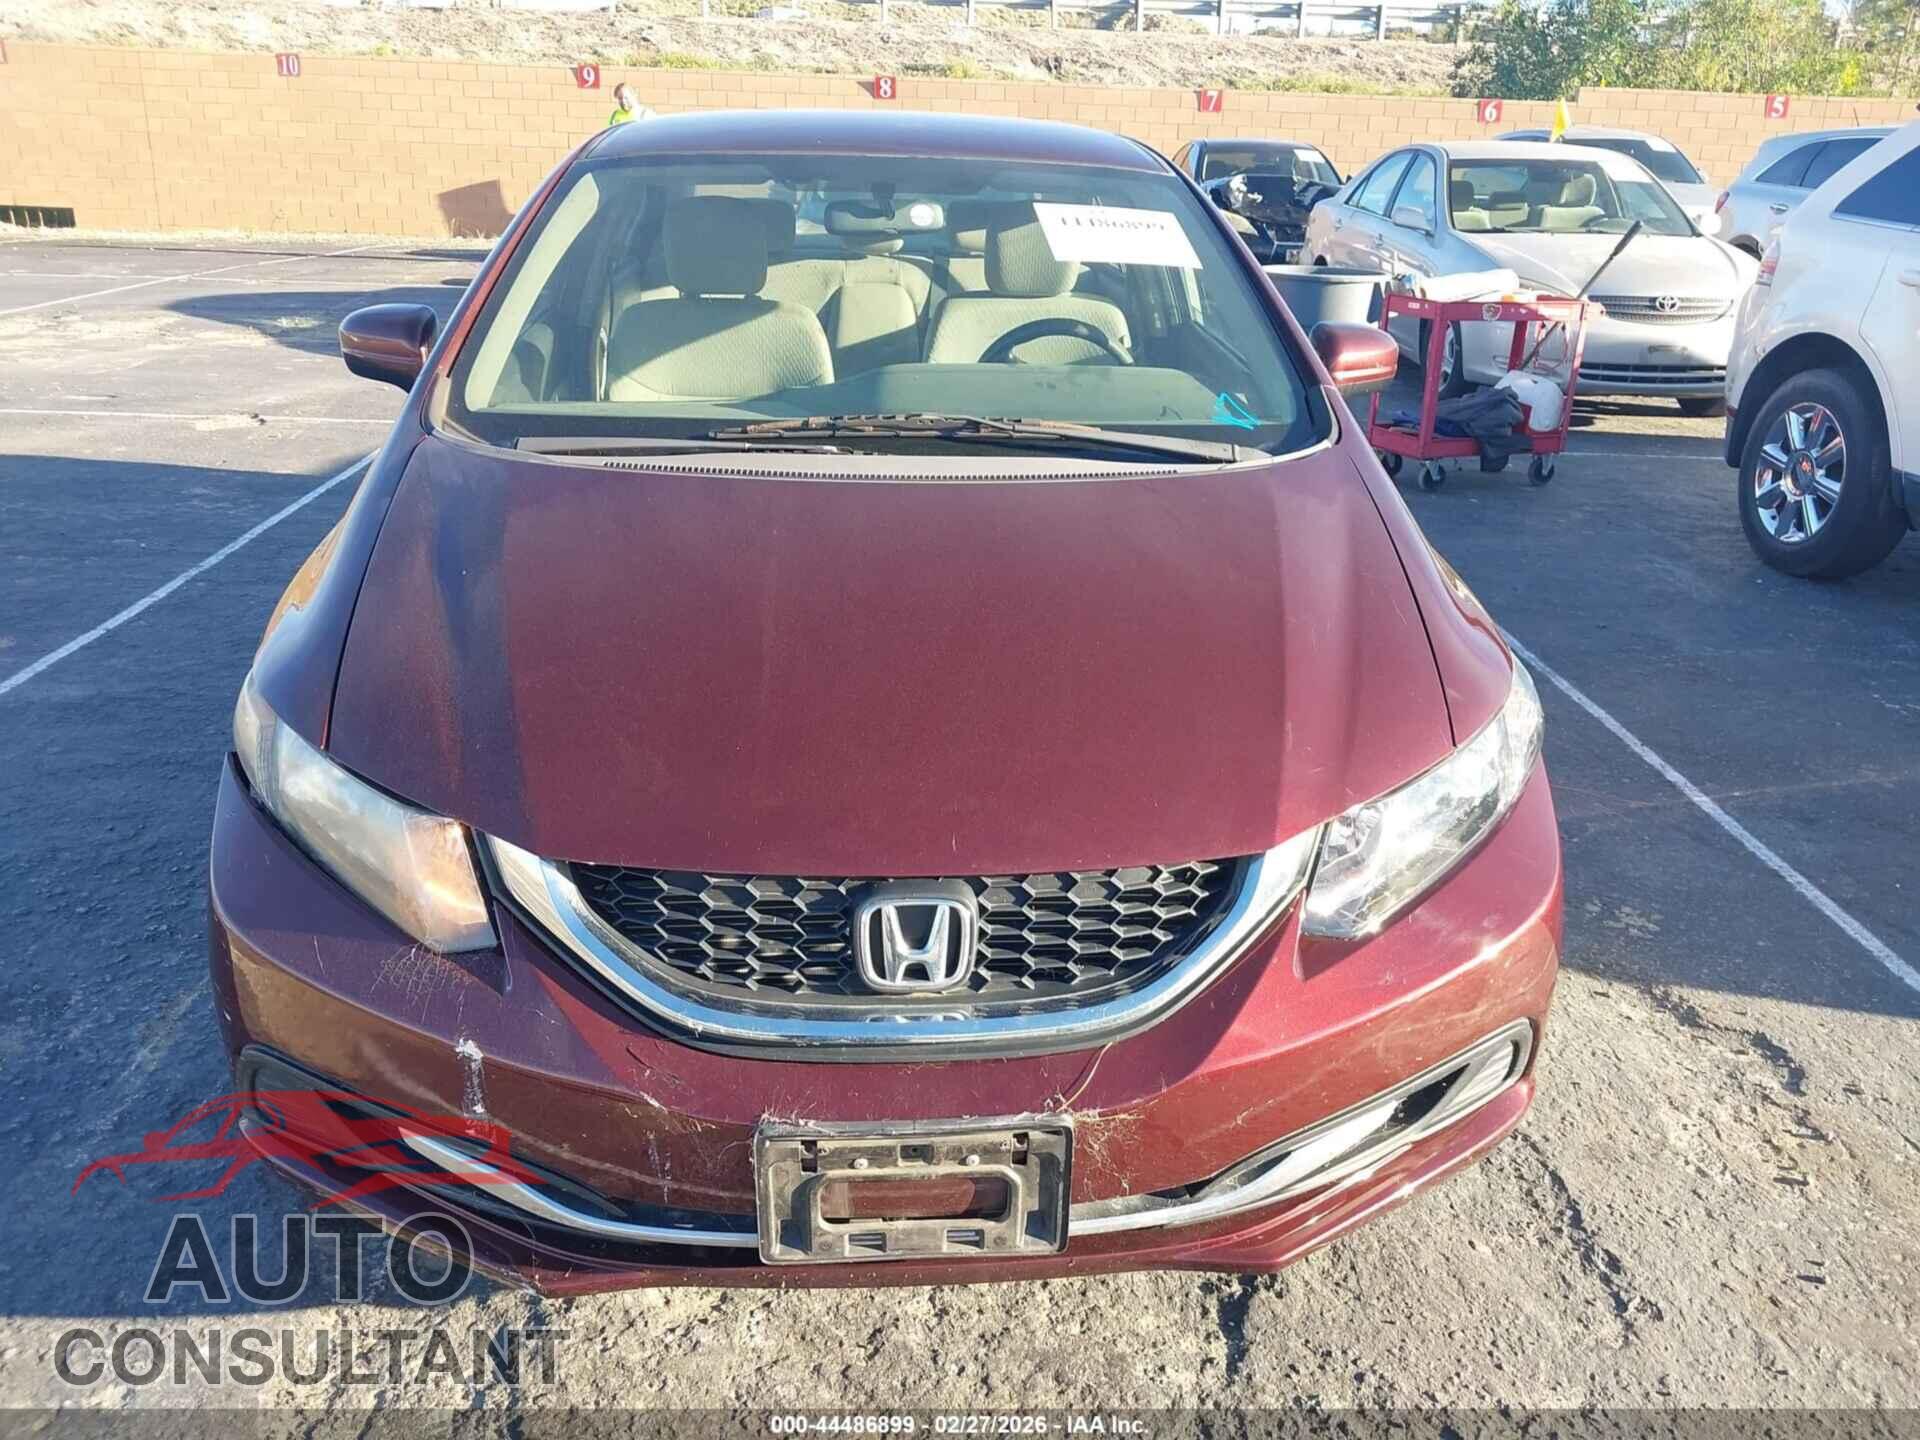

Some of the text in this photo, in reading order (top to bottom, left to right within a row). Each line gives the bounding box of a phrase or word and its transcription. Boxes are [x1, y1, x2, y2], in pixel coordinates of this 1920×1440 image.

[279, 55, 299, 75] 10
[582, 66, 596, 87] 9
[879, 76, 892, 98] 8
[1206, 90, 1219, 111] 7
[1484, 100, 1499, 122] 6
[1770, 95, 1786, 118] 5
